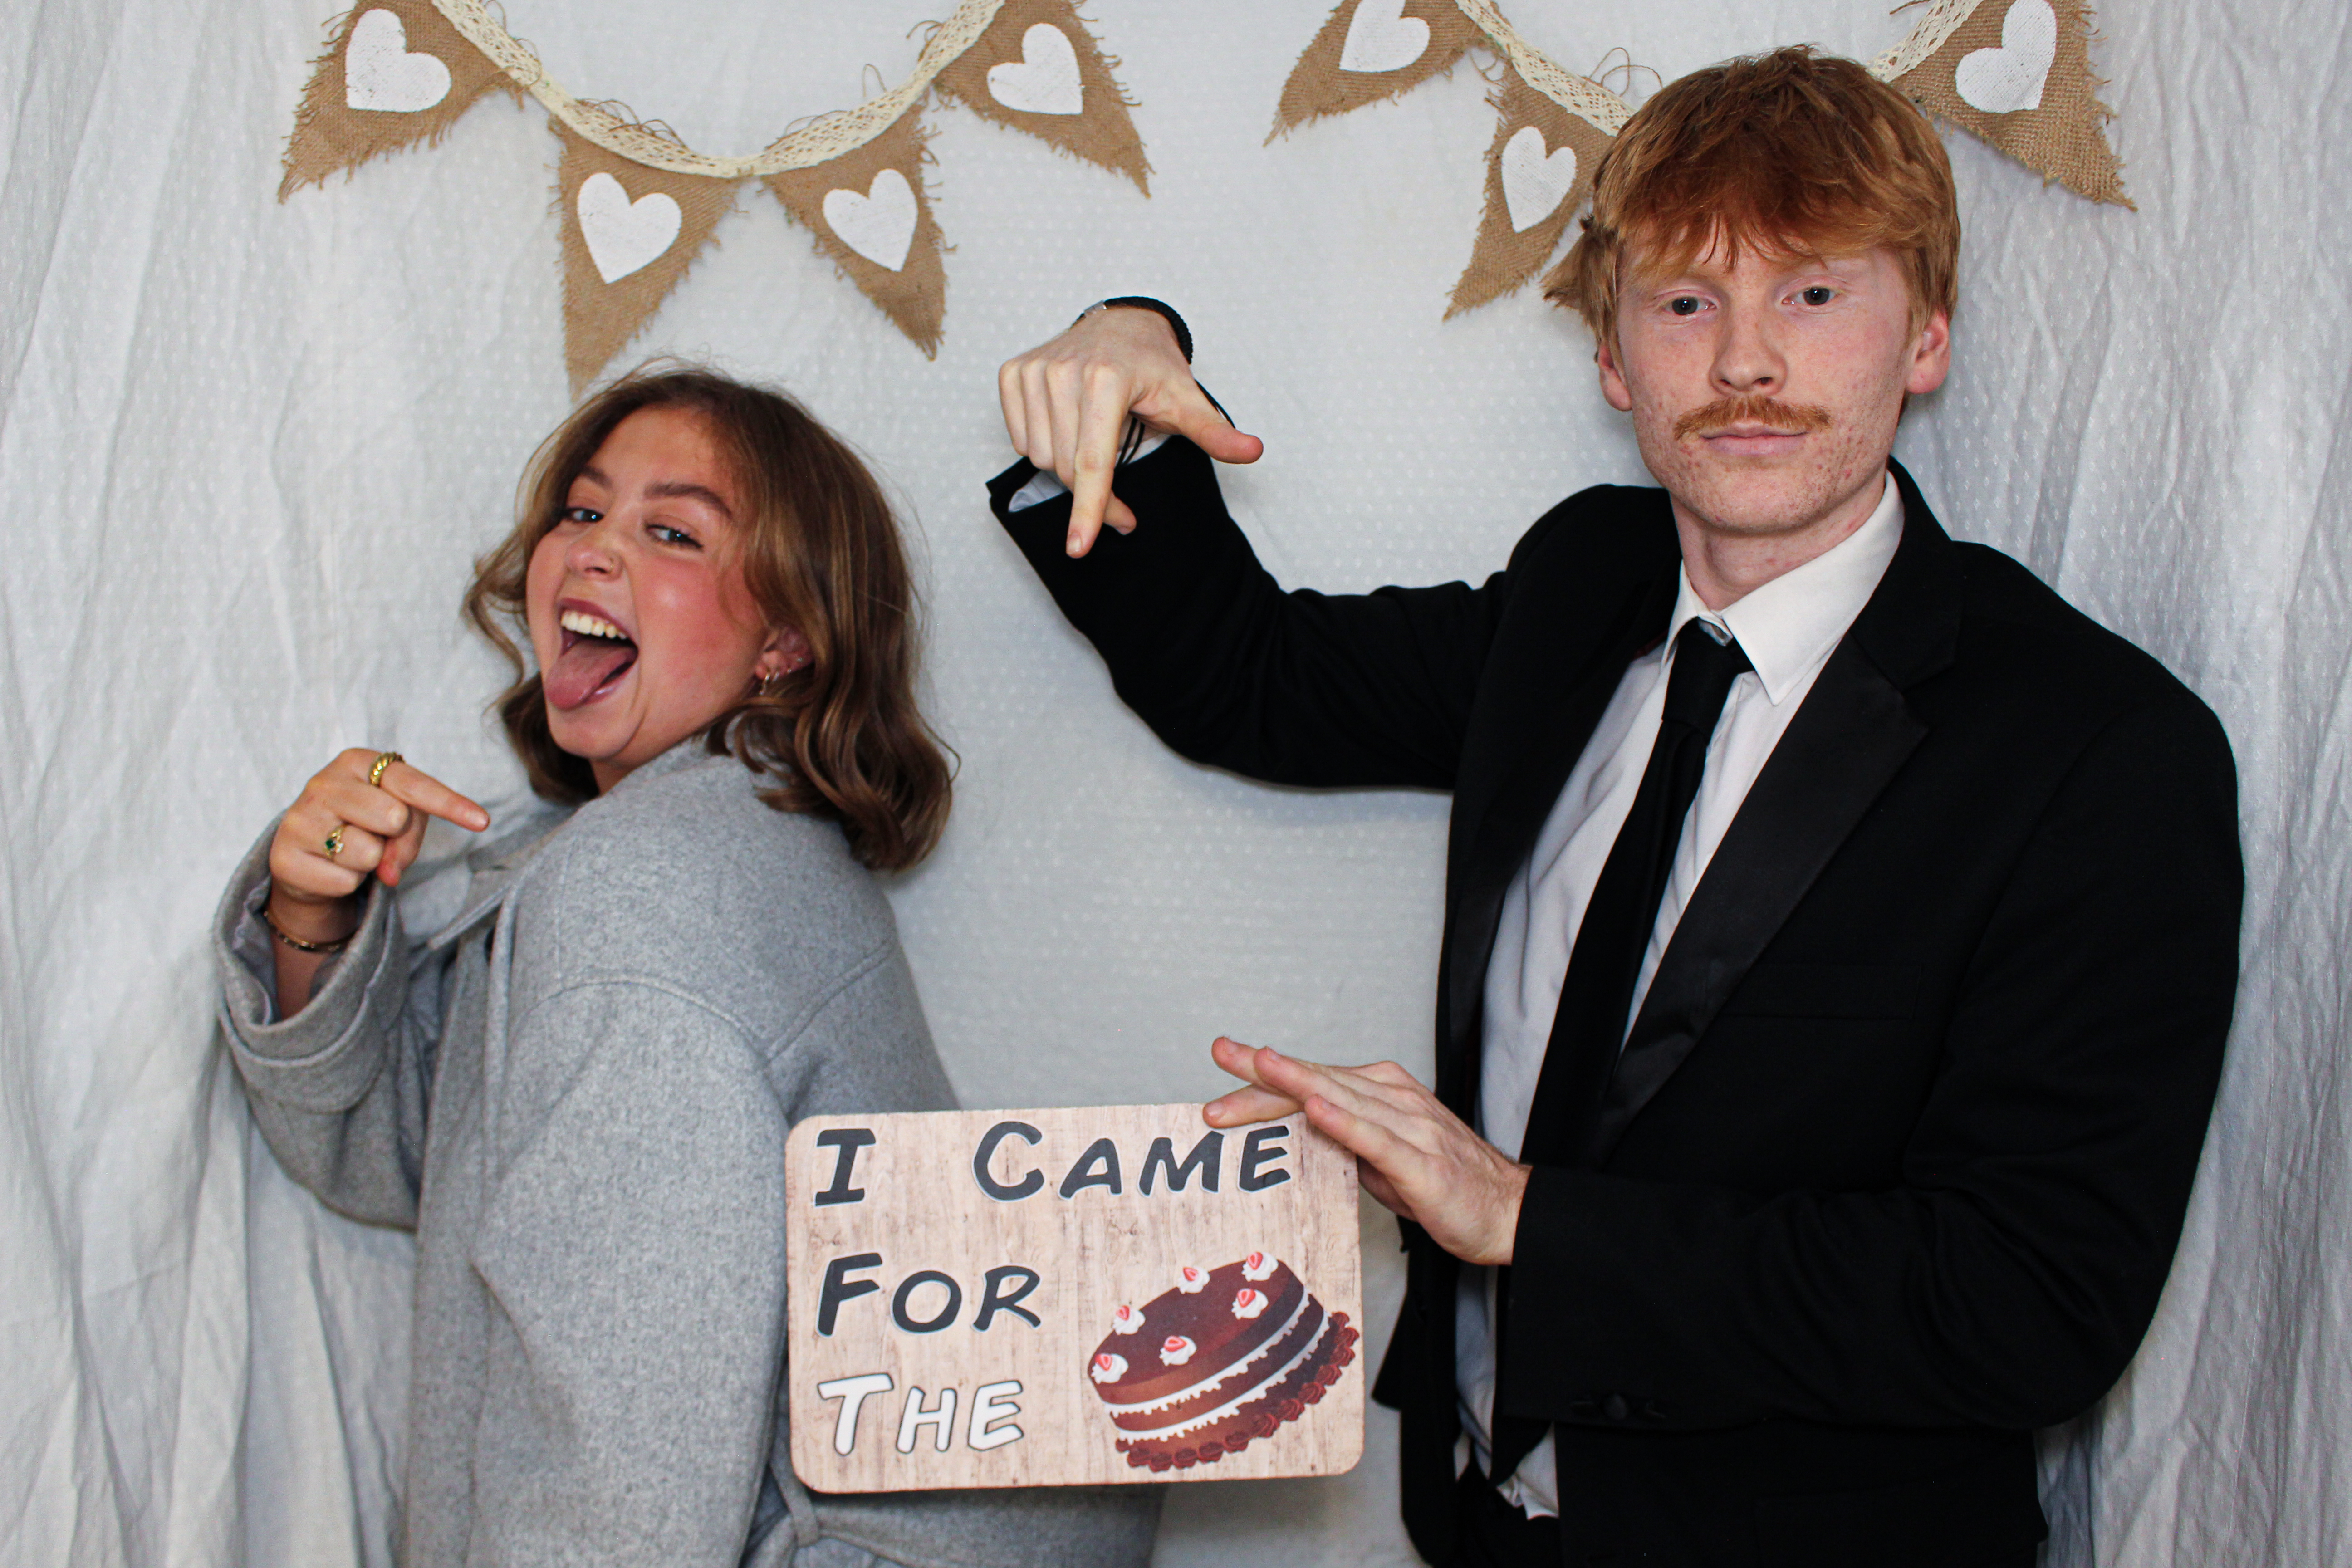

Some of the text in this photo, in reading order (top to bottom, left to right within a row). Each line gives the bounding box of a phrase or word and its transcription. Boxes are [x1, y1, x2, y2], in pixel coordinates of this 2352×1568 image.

[815, 1121, 1291, 1207] I CAME
[817, 1252, 1042, 1337] FOR
[818, 1373, 1025, 1457] THE
